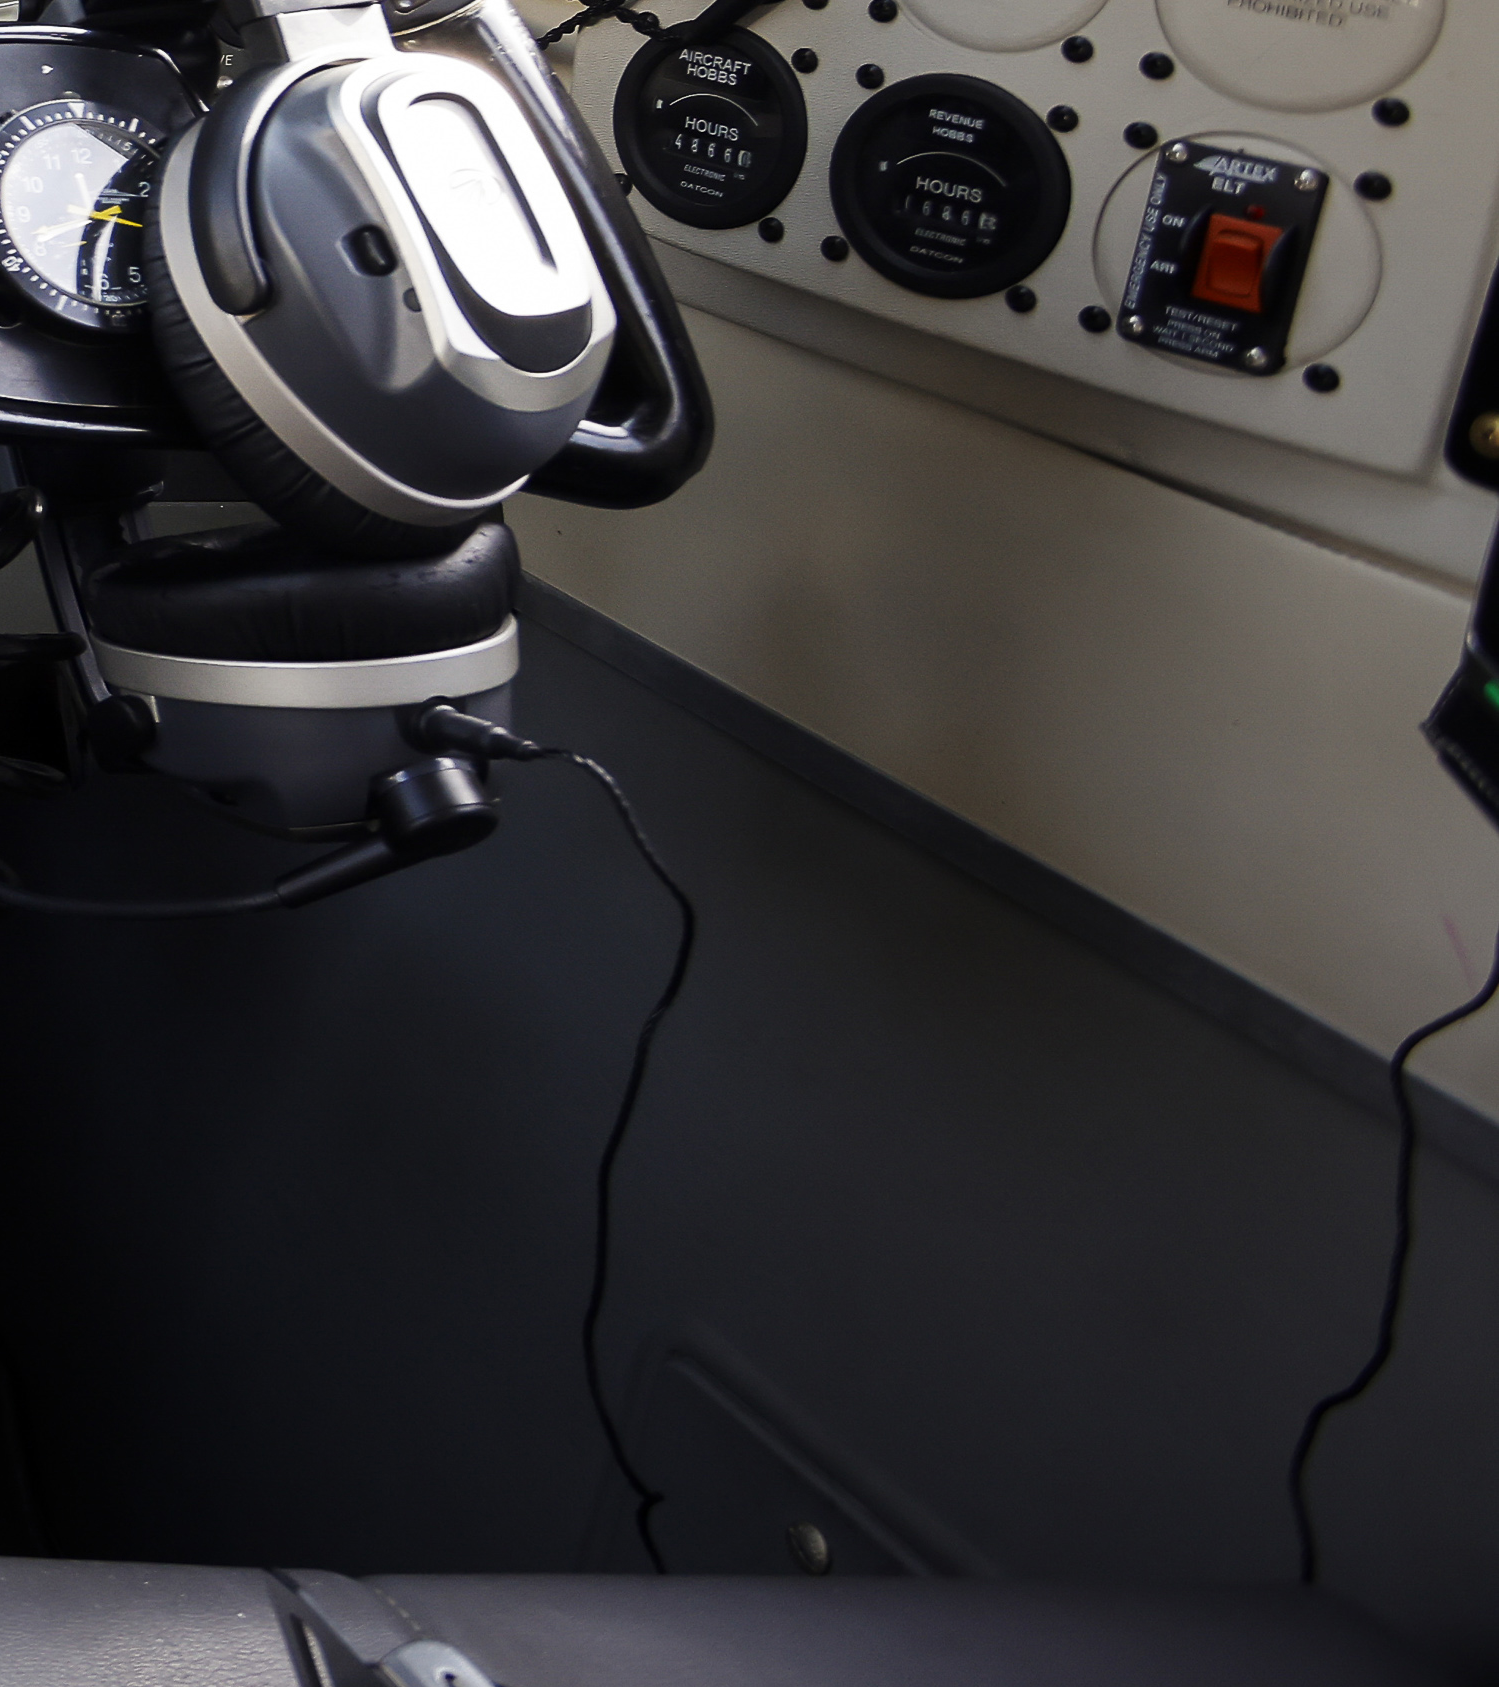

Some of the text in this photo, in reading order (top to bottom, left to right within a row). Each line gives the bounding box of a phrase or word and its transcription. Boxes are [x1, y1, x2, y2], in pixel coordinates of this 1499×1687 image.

[679, 49, 751, 75] AIRCRAFT
[687, 64, 737, 85] HOBBS
[685, 116, 739, 142] HOURS
